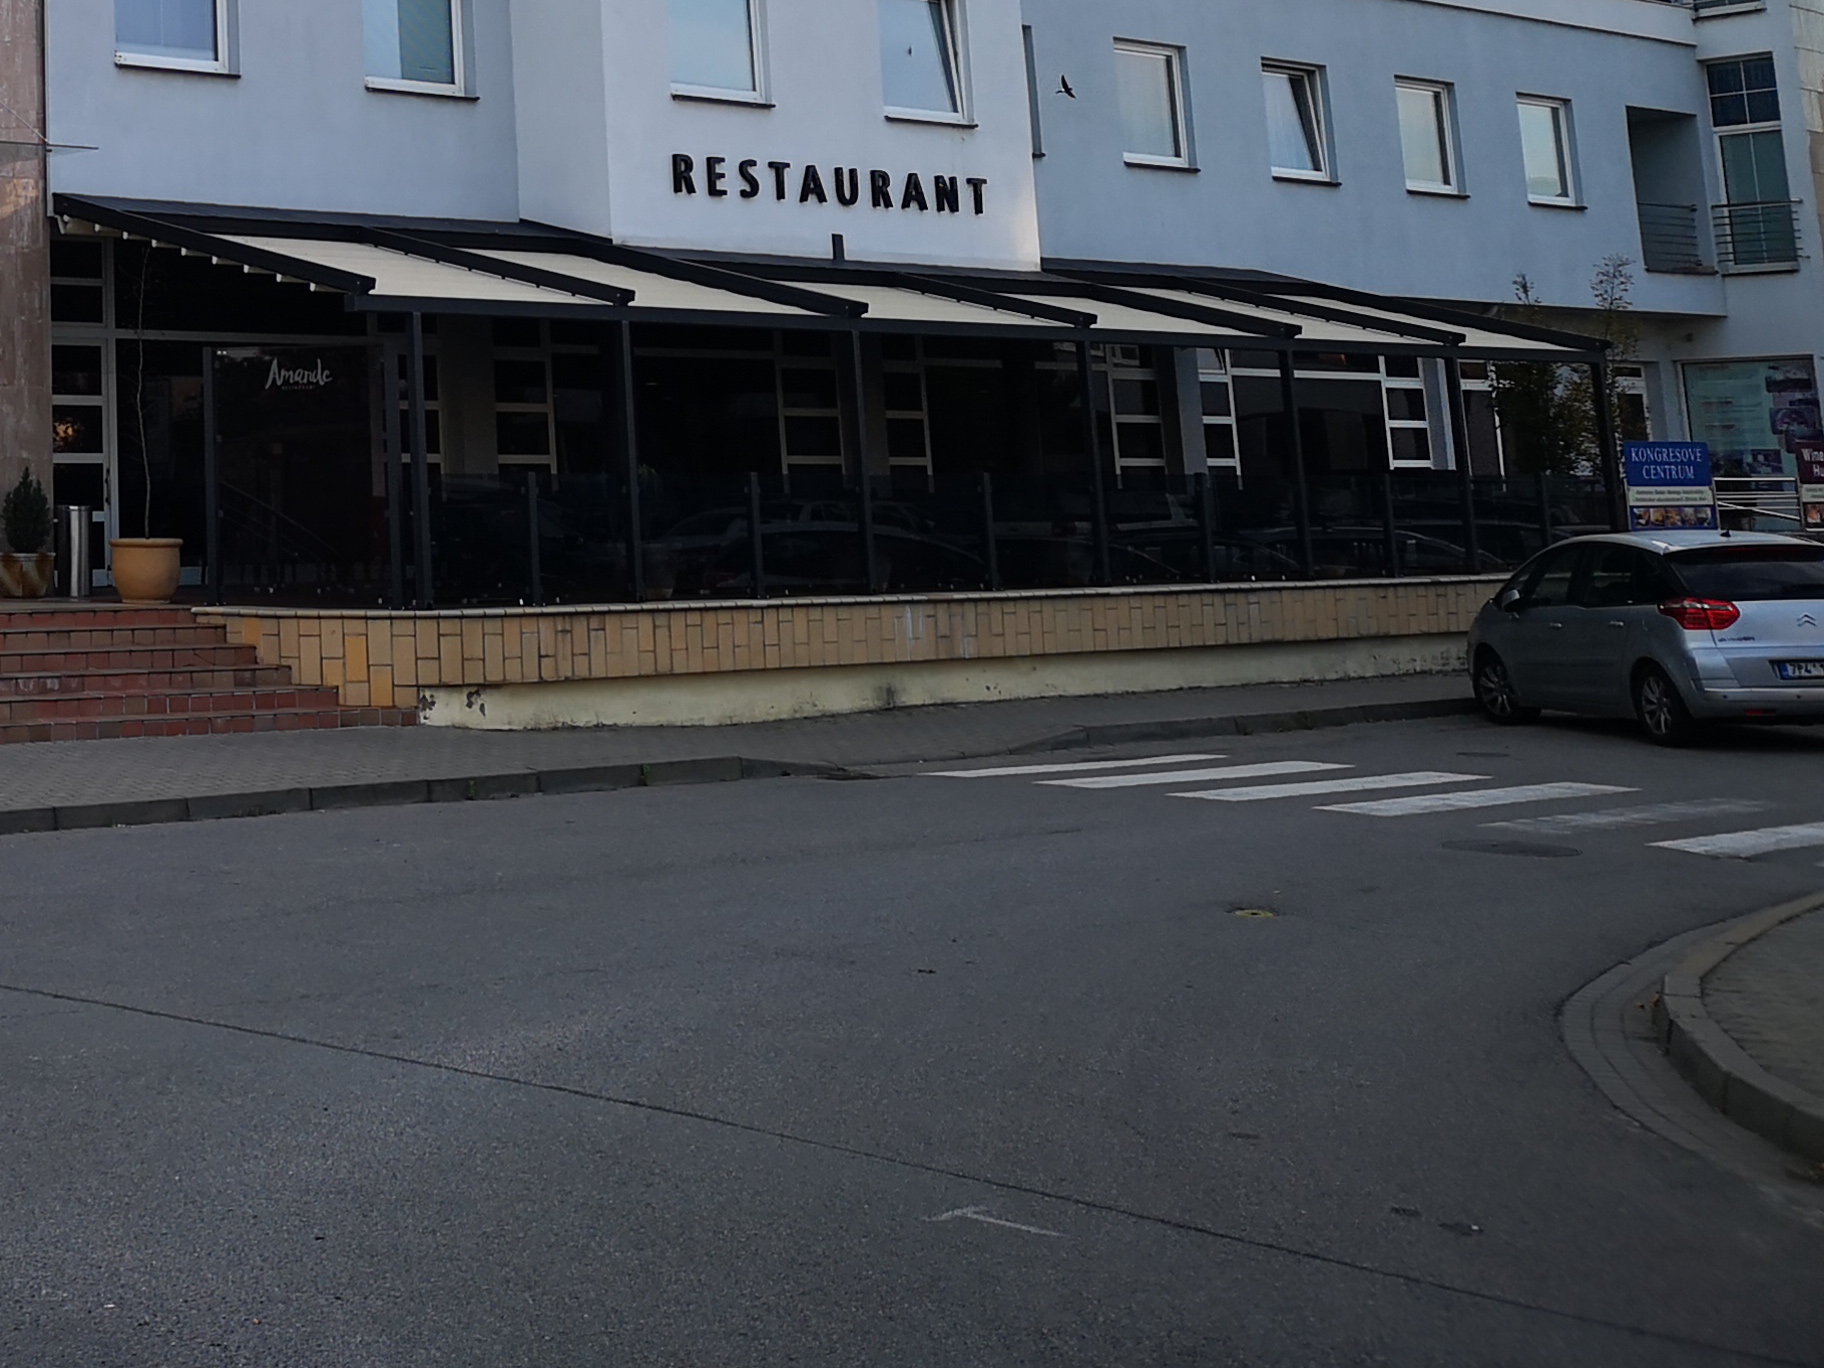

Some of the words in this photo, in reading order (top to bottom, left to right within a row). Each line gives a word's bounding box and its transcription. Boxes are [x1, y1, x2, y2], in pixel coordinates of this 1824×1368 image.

[672, 153, 988, 215] RESTAURANT
[265, 357, 333, 389] Amande
[1642, 465, 1695, 479] CENTRUM
